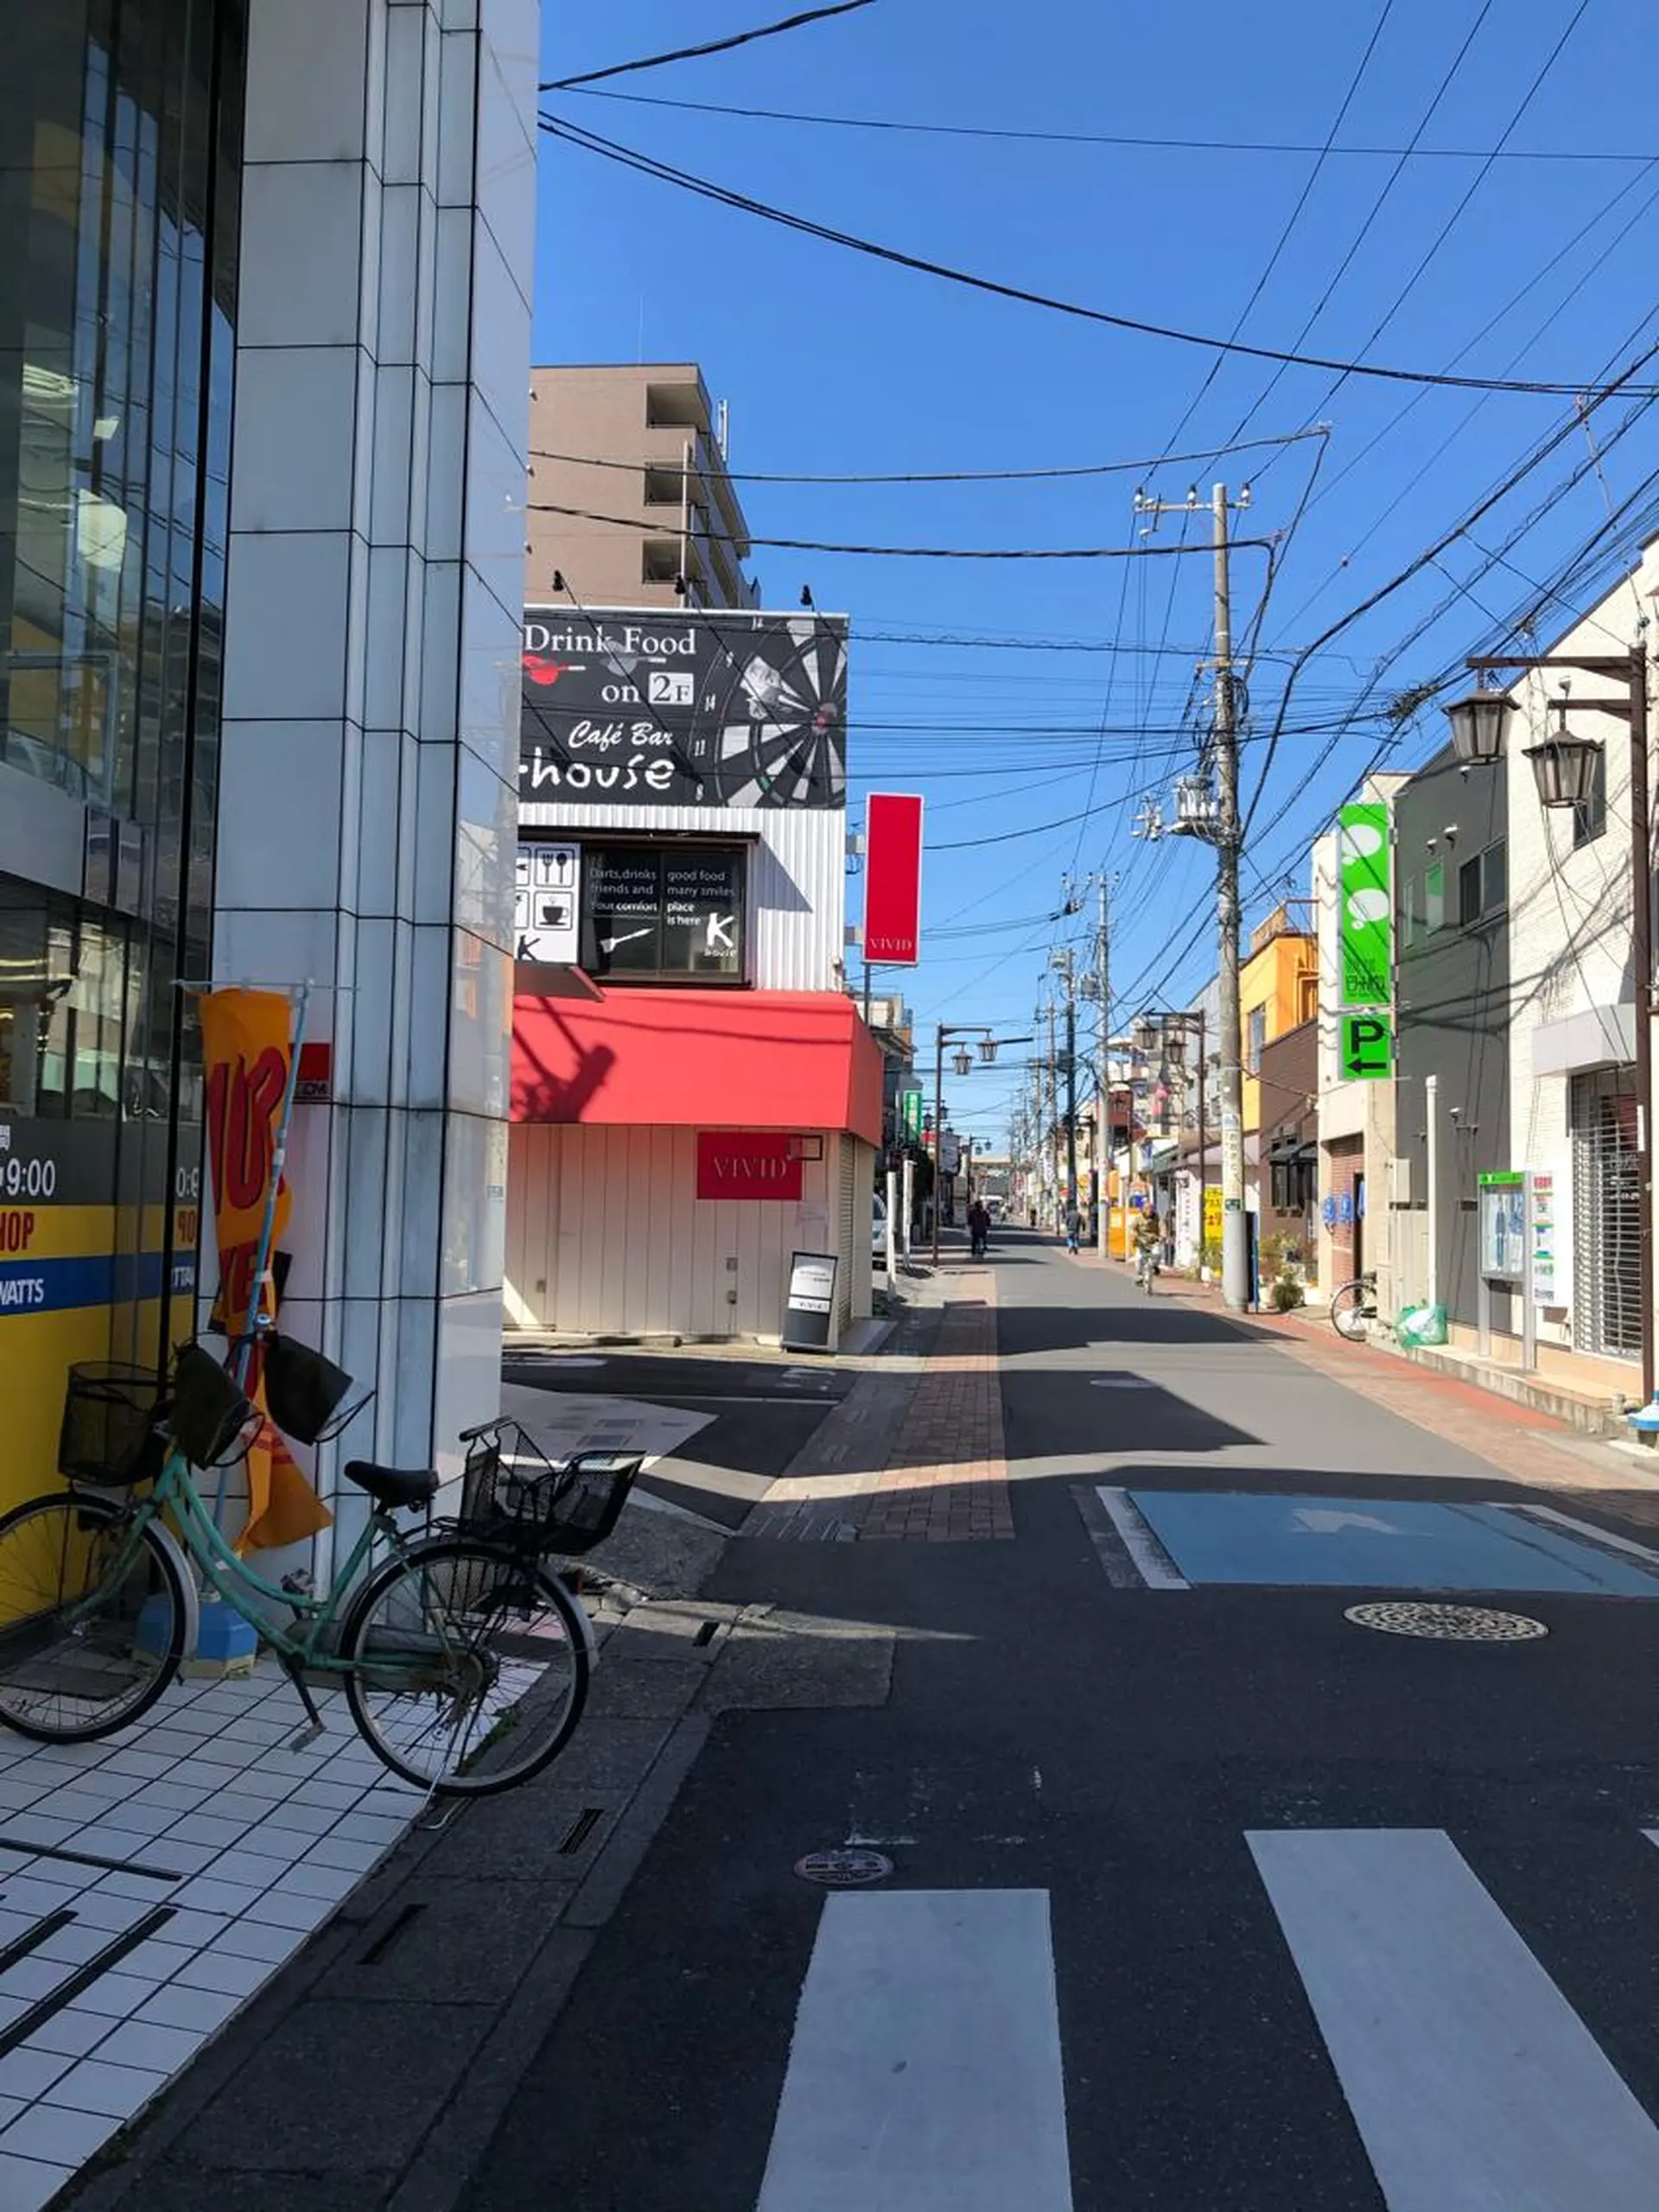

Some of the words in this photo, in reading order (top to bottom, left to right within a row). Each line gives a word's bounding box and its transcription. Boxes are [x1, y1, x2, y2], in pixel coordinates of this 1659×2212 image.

[524, 624, 613, 652] Drink
[623, 628, 697, 655] Food
[601, 683, 640, 703] on
[652, 675, 690, 702] 2F
[568, 720, 624, 753] Café
[631, 721, 673, 747] Bar
[632, 885, 654, 895] and
[667, 901, 695, 913] place
[677, 916, 702, 925] here
[706, 912, 735, 948] K
[1351, 1020, 1385, 1054] P
[0, 1158, 56, 1197] 9:00
[714, 1156, 787, 1179] VIVID
